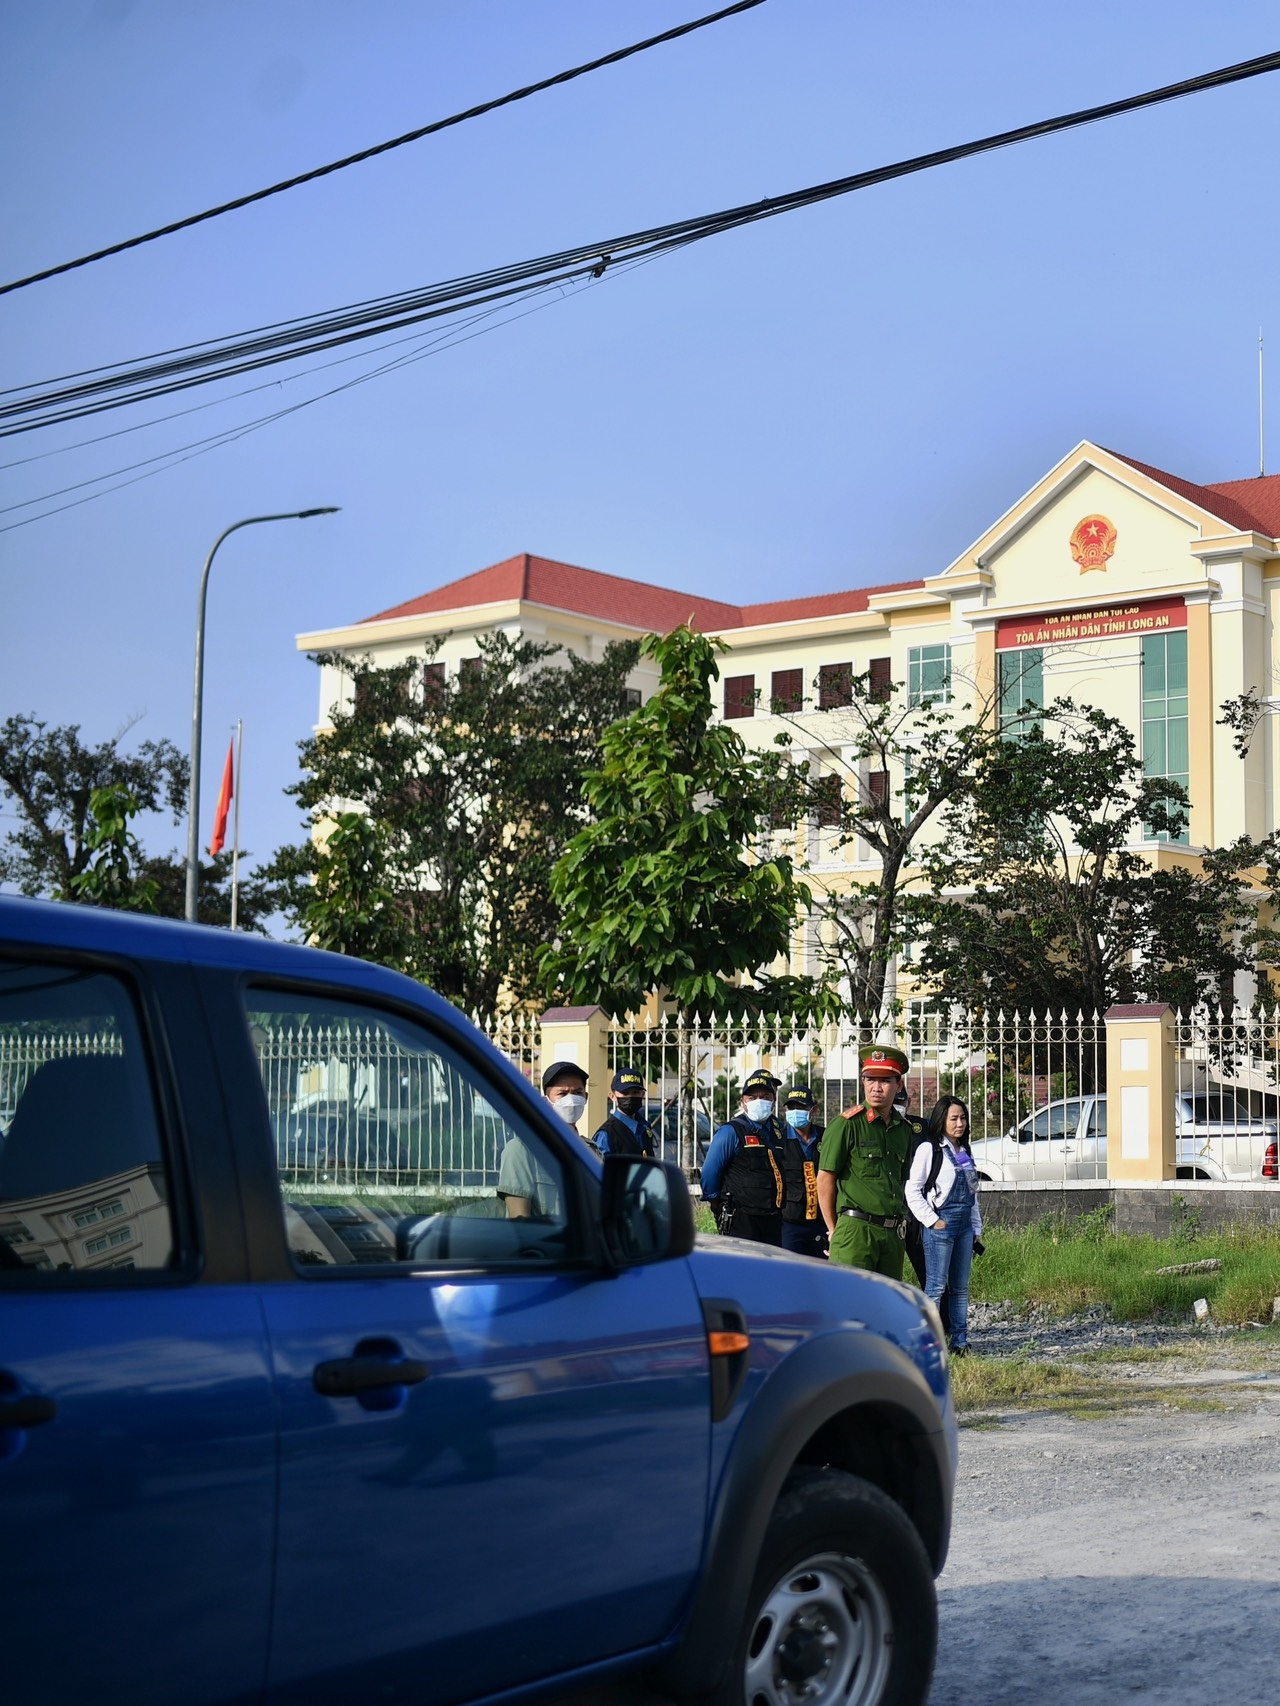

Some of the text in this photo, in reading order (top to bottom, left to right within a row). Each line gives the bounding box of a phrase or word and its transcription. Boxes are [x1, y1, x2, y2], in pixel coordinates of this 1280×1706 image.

[1016, 615, 1170, 644] TÒA ÁN NHÂN DÂN TỈNH LONG AN
[804, 1163, 815, 1218] SECURITY
